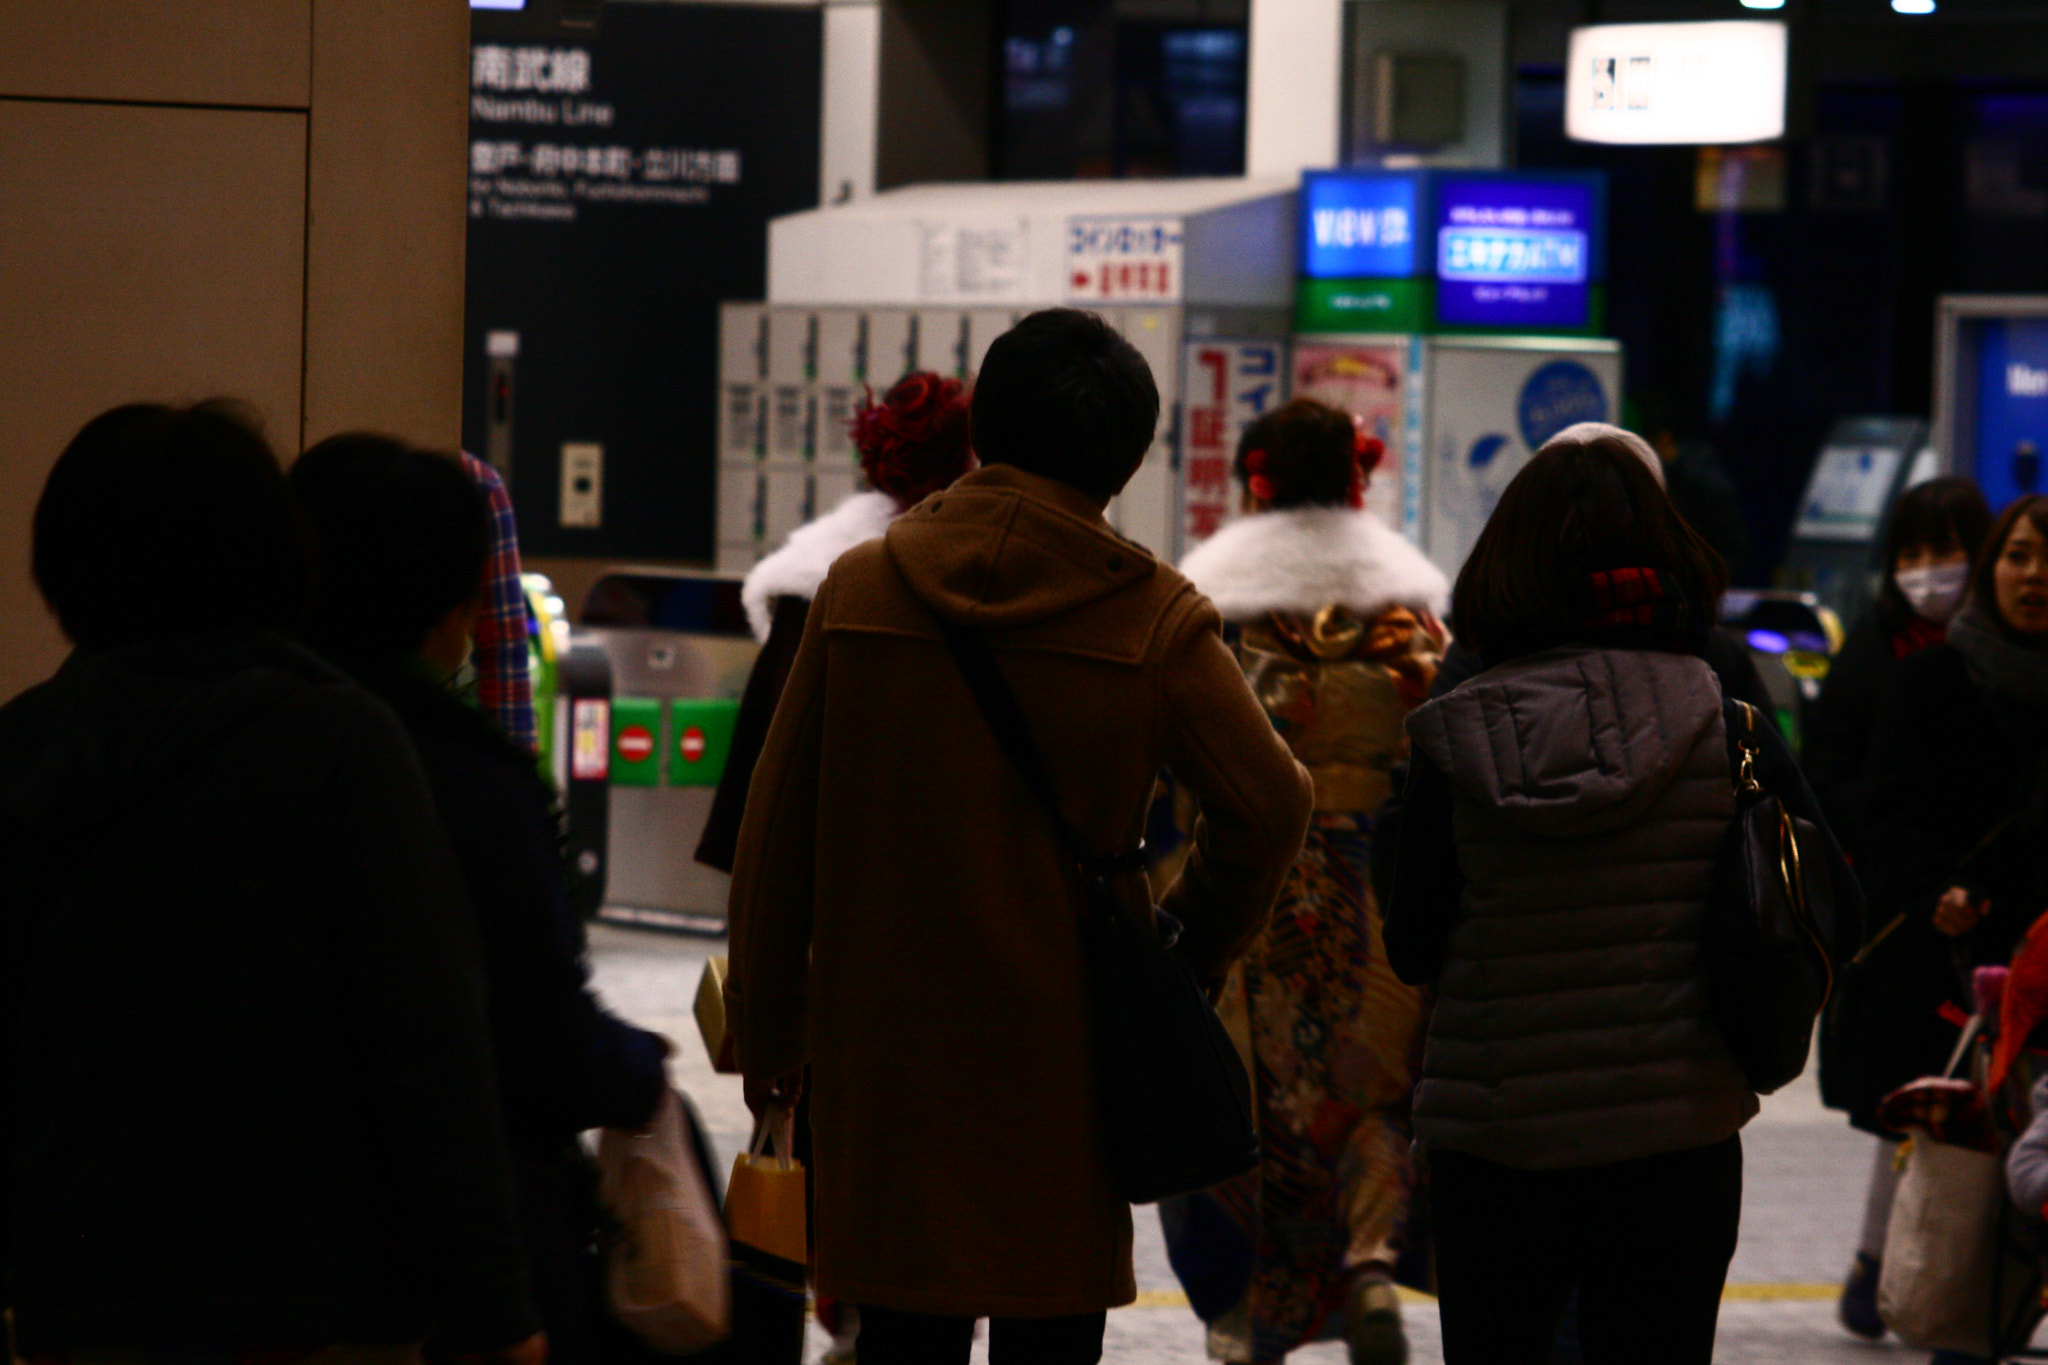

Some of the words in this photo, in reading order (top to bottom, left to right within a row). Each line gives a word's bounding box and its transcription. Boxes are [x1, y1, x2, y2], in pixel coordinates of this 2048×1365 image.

[472, 47, 590, 92] 南武線
[471, 96, 557, 125] Nambu
[562, 100, 614, 127] Line
